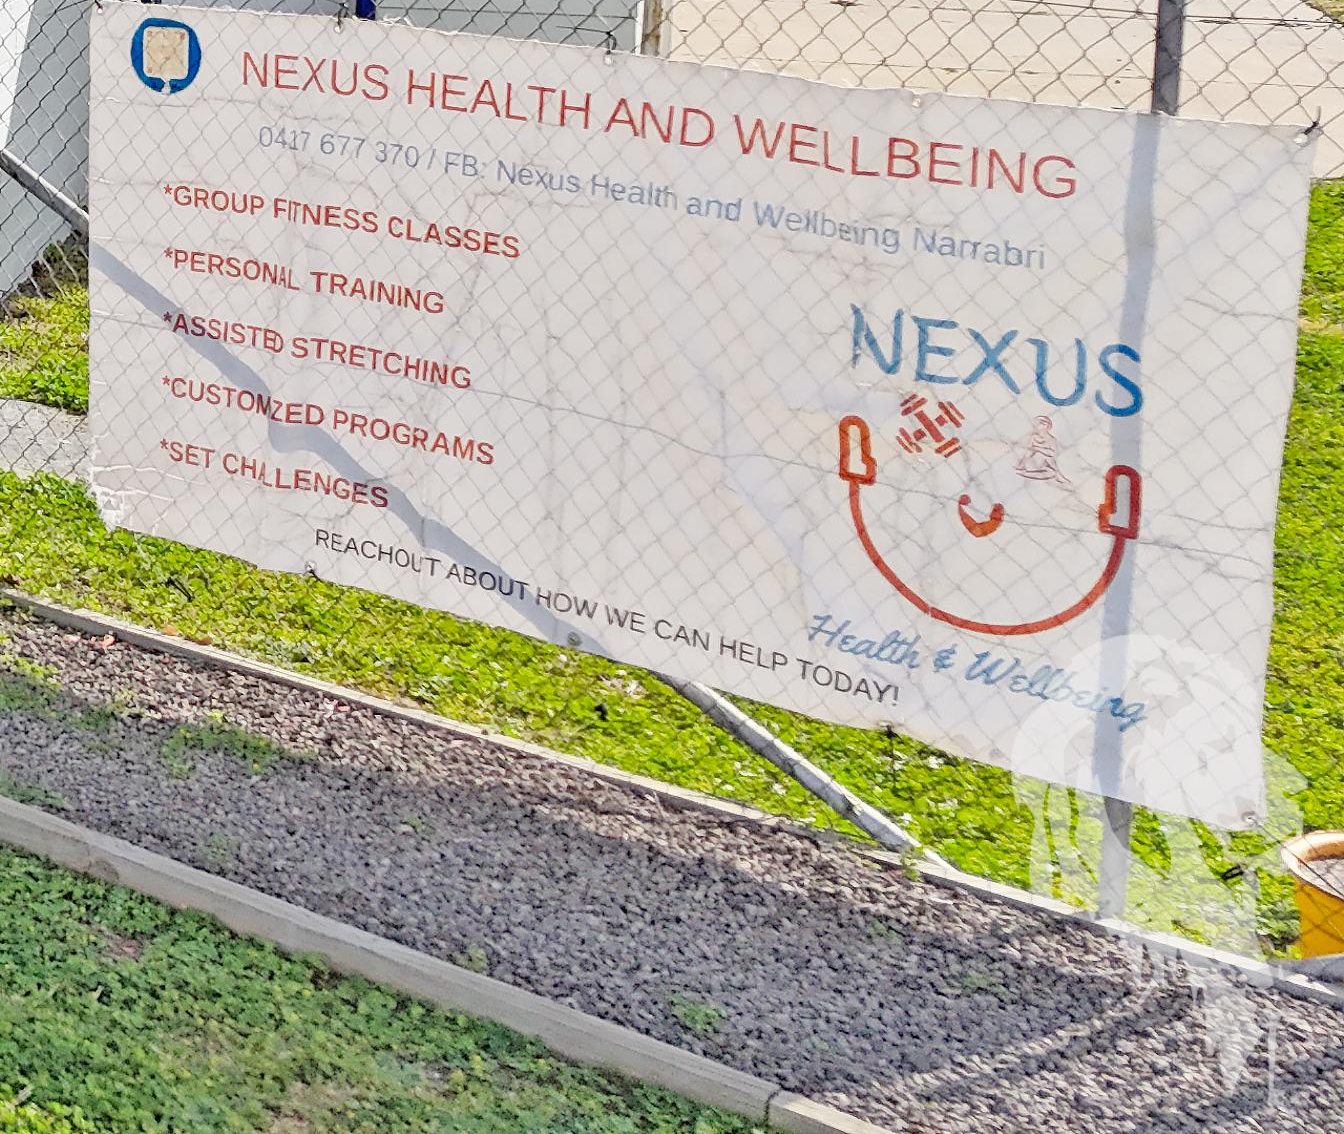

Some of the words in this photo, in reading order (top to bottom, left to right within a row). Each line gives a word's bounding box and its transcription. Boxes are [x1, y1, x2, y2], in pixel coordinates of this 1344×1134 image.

[242, 51, 389, 101] NEXUS
[407, 69, 592, 130] HEALTH
[604, 97, 714, 147] AND
[733, 114, 1077, 199] WELLBEING
[258, 126, 311, 152] 0417
[320, 133, 365, 159] 677
[375, 141, 420, 168] 370
[426, 148, 437, 170] /
[445, 151, 485, 178] FB:
[497, 160, 581, 193] Nexus
[591, 174, 678, 210] Health
[686, 195, 743, 222] and
[752, 201, 901, 254] Wellbeing
[913, 226, 1046, 269] Narrabri
[273, 197, 378, 233] FITNESS
[388, 215, 521, 259] CLASSES
[310, 271, 444, 314] TRAINING
[290, 336, 471, 390] STRETCHING
[850, 303, 1144, 417] NEXUS
[333, 409, 494, 465] PROGRAMS
[315, 528, 441, 577] REACHOUT
[445, 563, 529, 600] ABOUT
[536, 586, 598, 619] HOW
[605, 604, 646, 633] WE
[654, 619, 710, 651] CAN
[719, 635, 788, 672] HELP
[796, 657, 900, 706] TODAY!
[808, 614, 921, 669] Health
[932, 642, 958, 672] &
[965, 651, 1147, 733] Wellbeing
